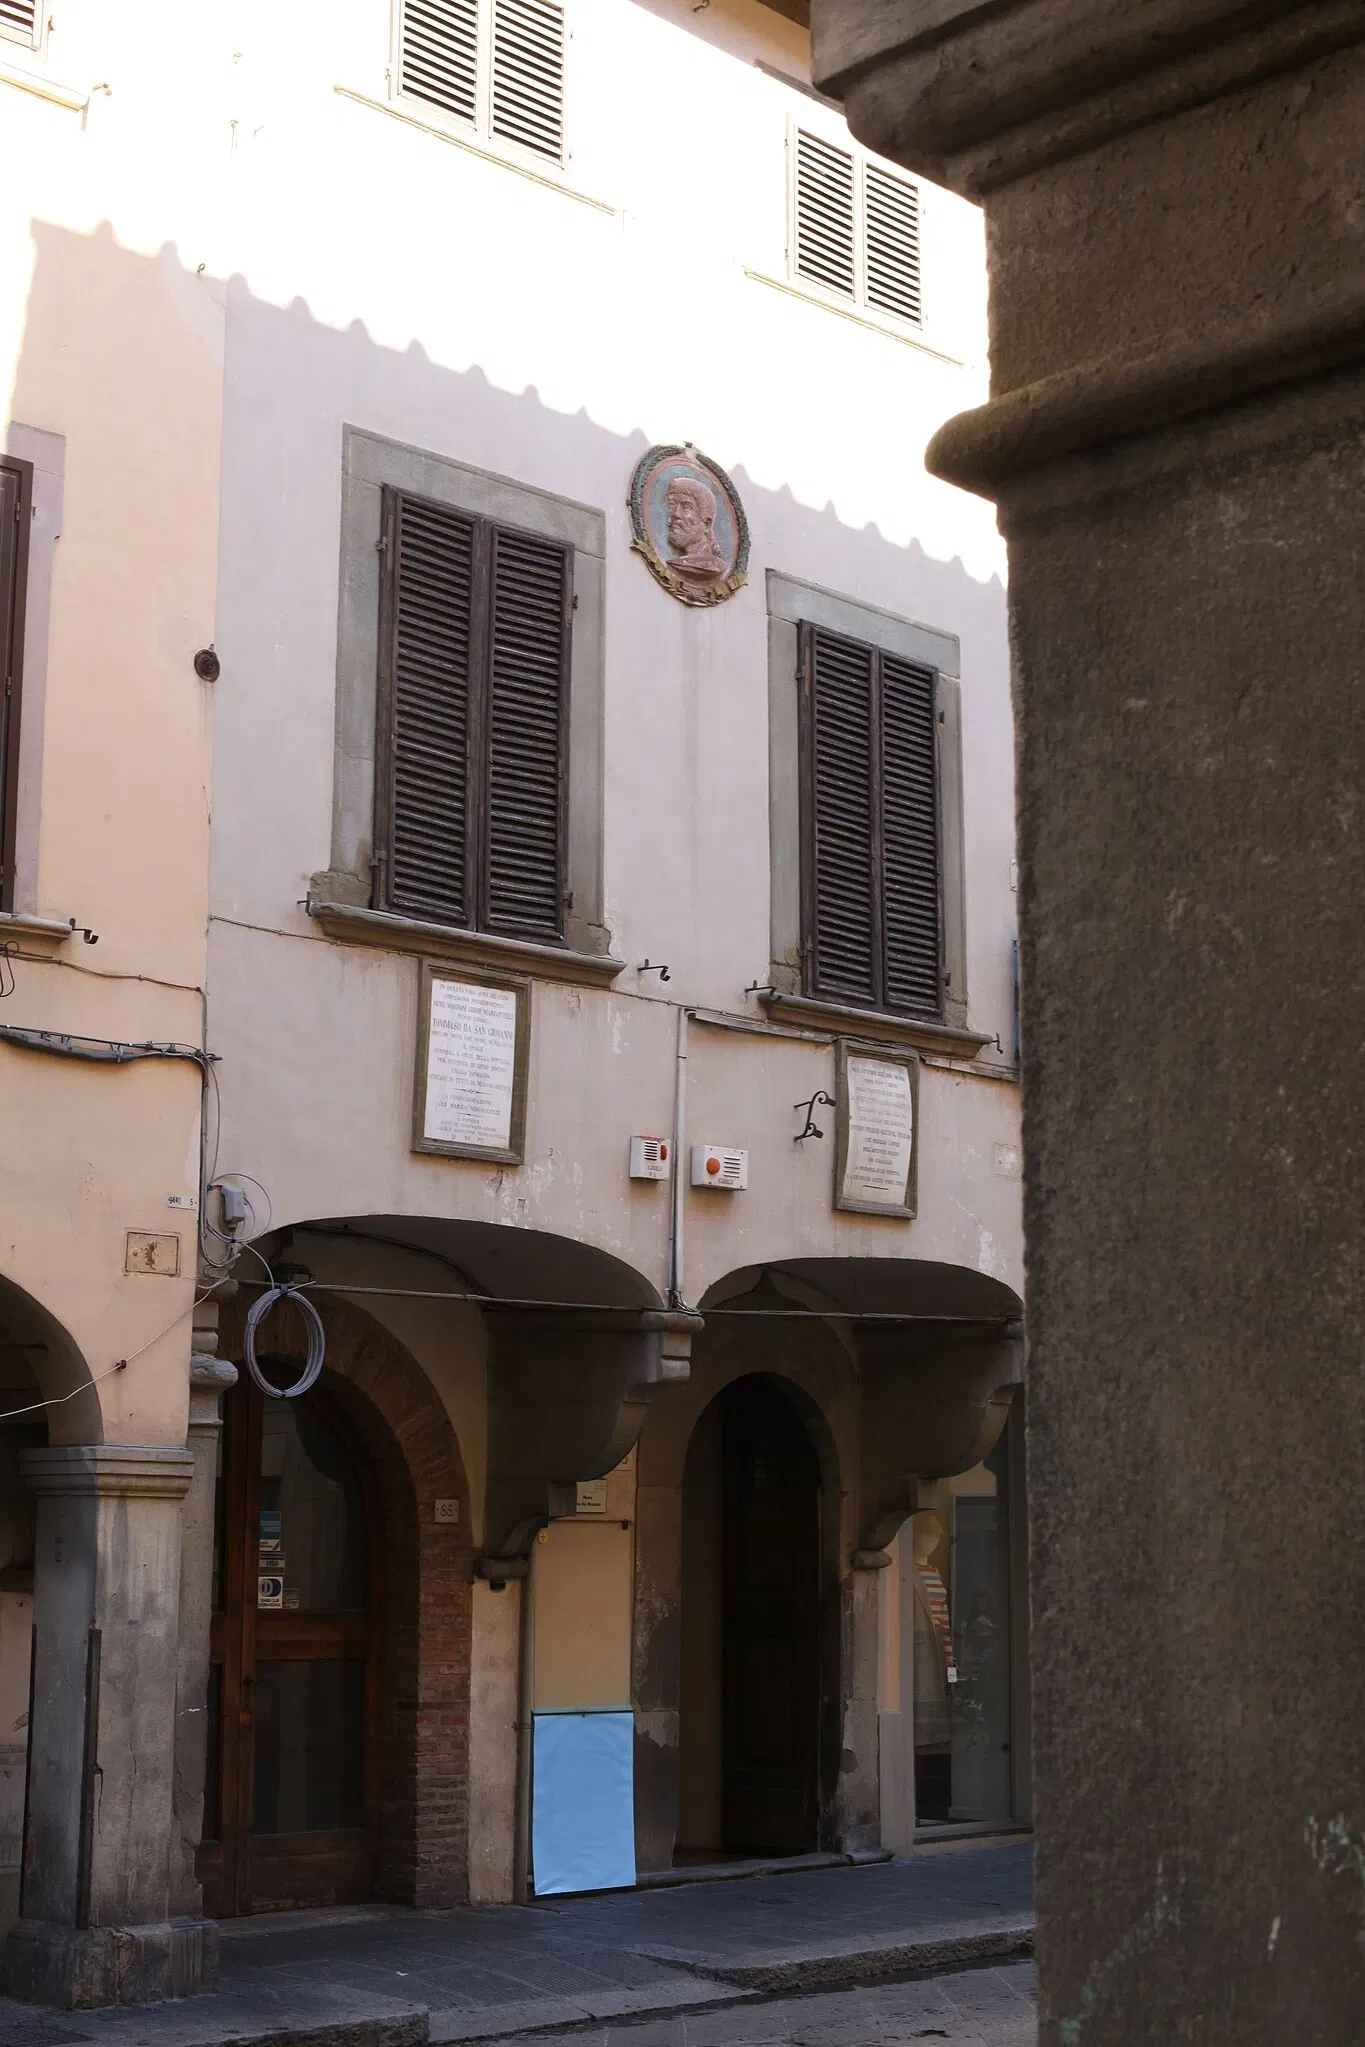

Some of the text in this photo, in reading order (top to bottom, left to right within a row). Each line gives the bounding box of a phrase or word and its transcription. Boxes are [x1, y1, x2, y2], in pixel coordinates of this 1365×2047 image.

[432, 1018, 461, 1031] TOMMASO
[463, 1023, 471, 1033] DA
[474, 1026, 486, 1035] SAN
[488, 1028, 513, 1040] GIOVANNI
